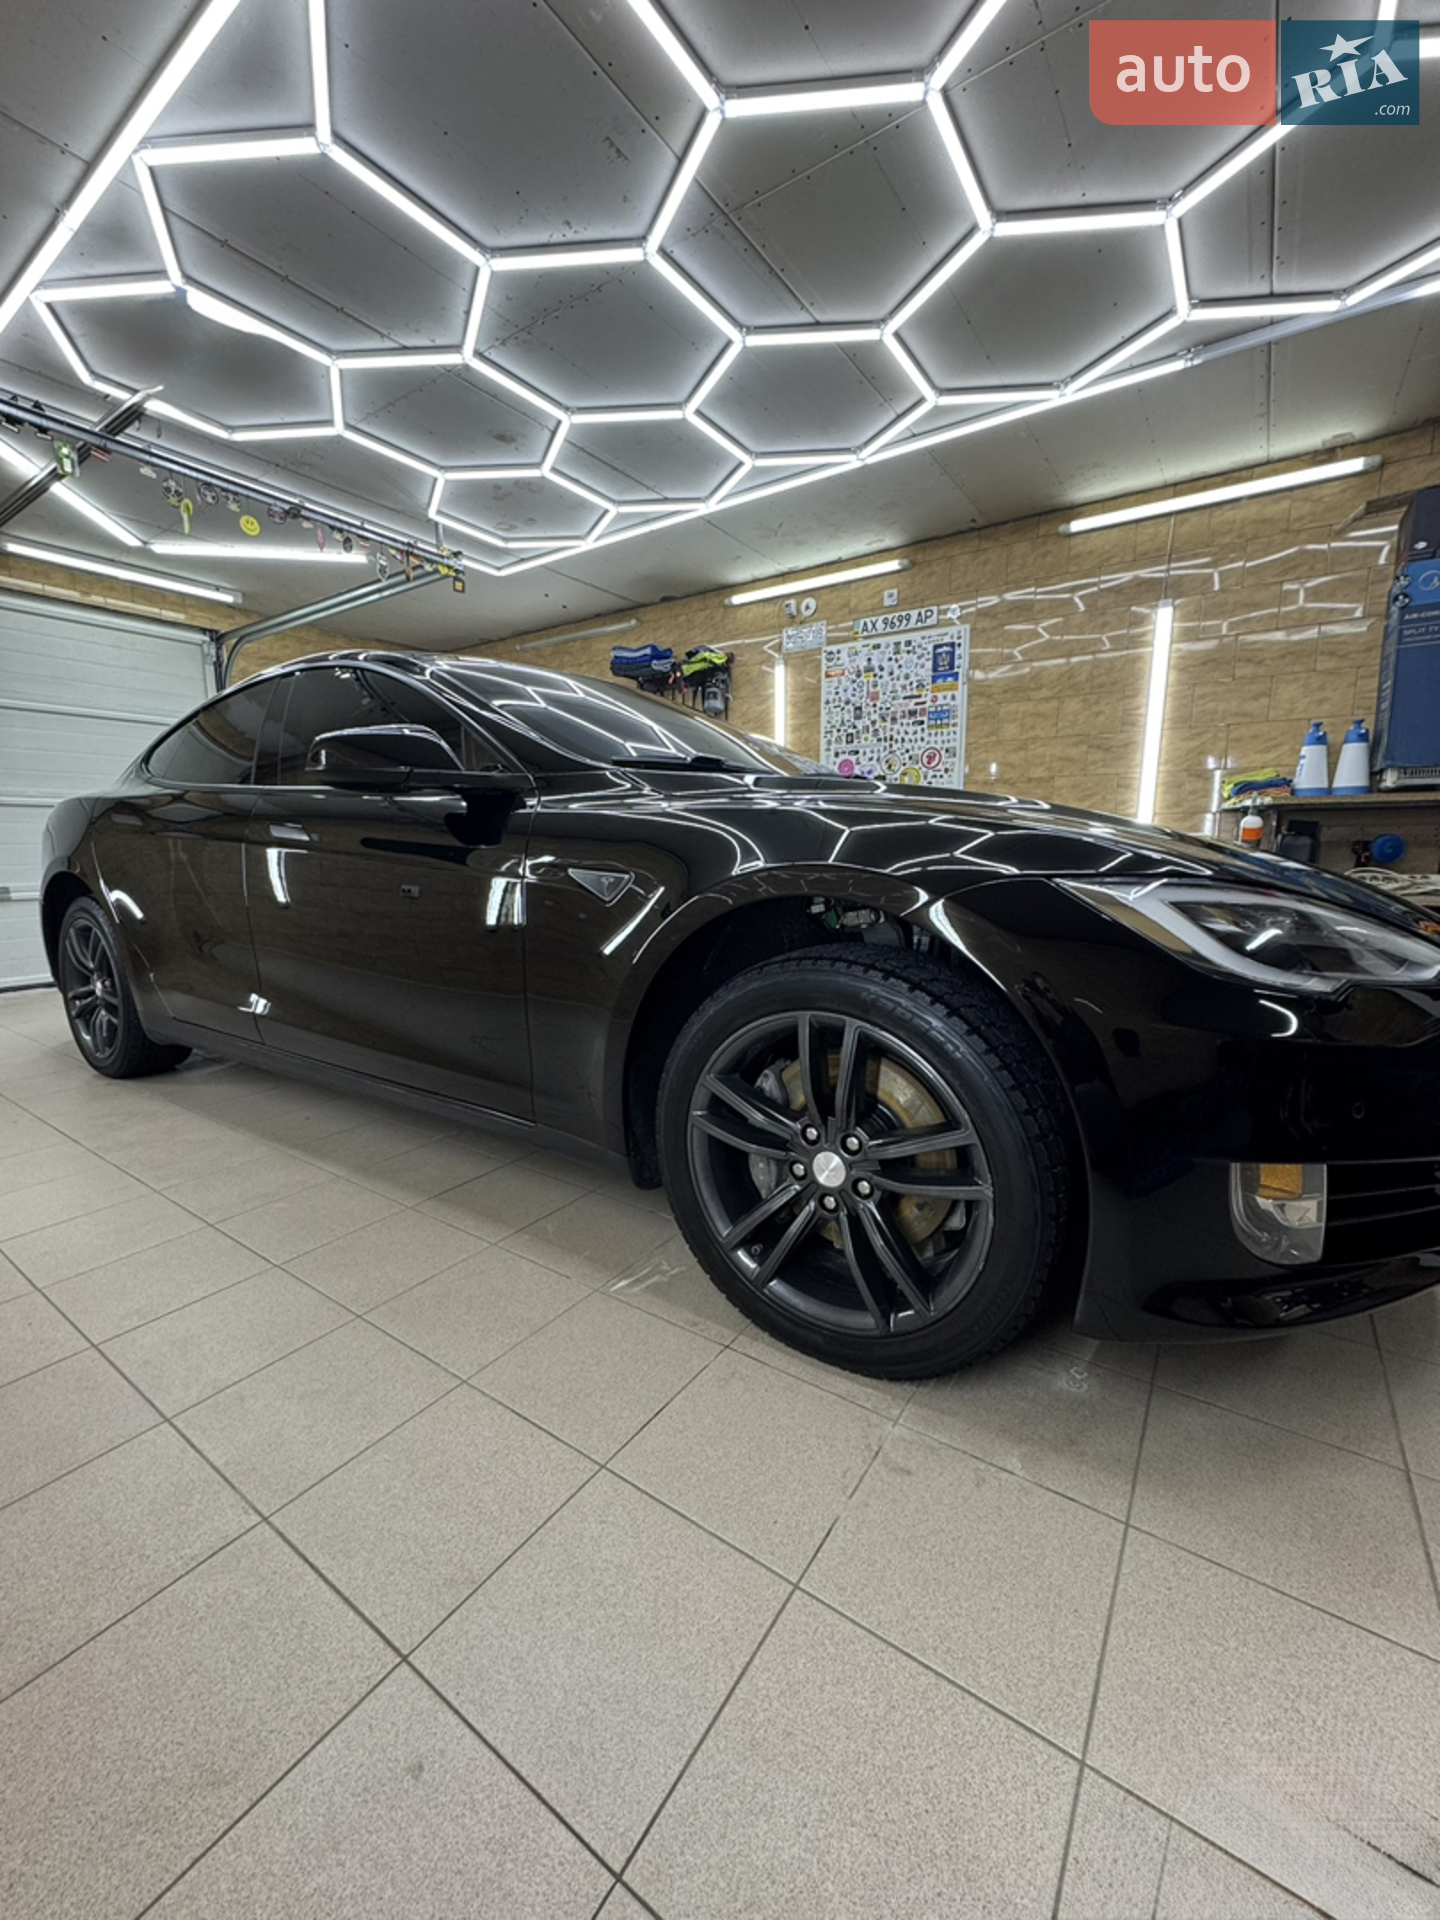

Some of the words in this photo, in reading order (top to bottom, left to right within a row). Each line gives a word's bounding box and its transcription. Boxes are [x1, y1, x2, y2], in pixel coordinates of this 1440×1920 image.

[860, 618, 879, 635] AX
[881, 612, 912, 632] 9699
[915, 609, 934, 625] AP
